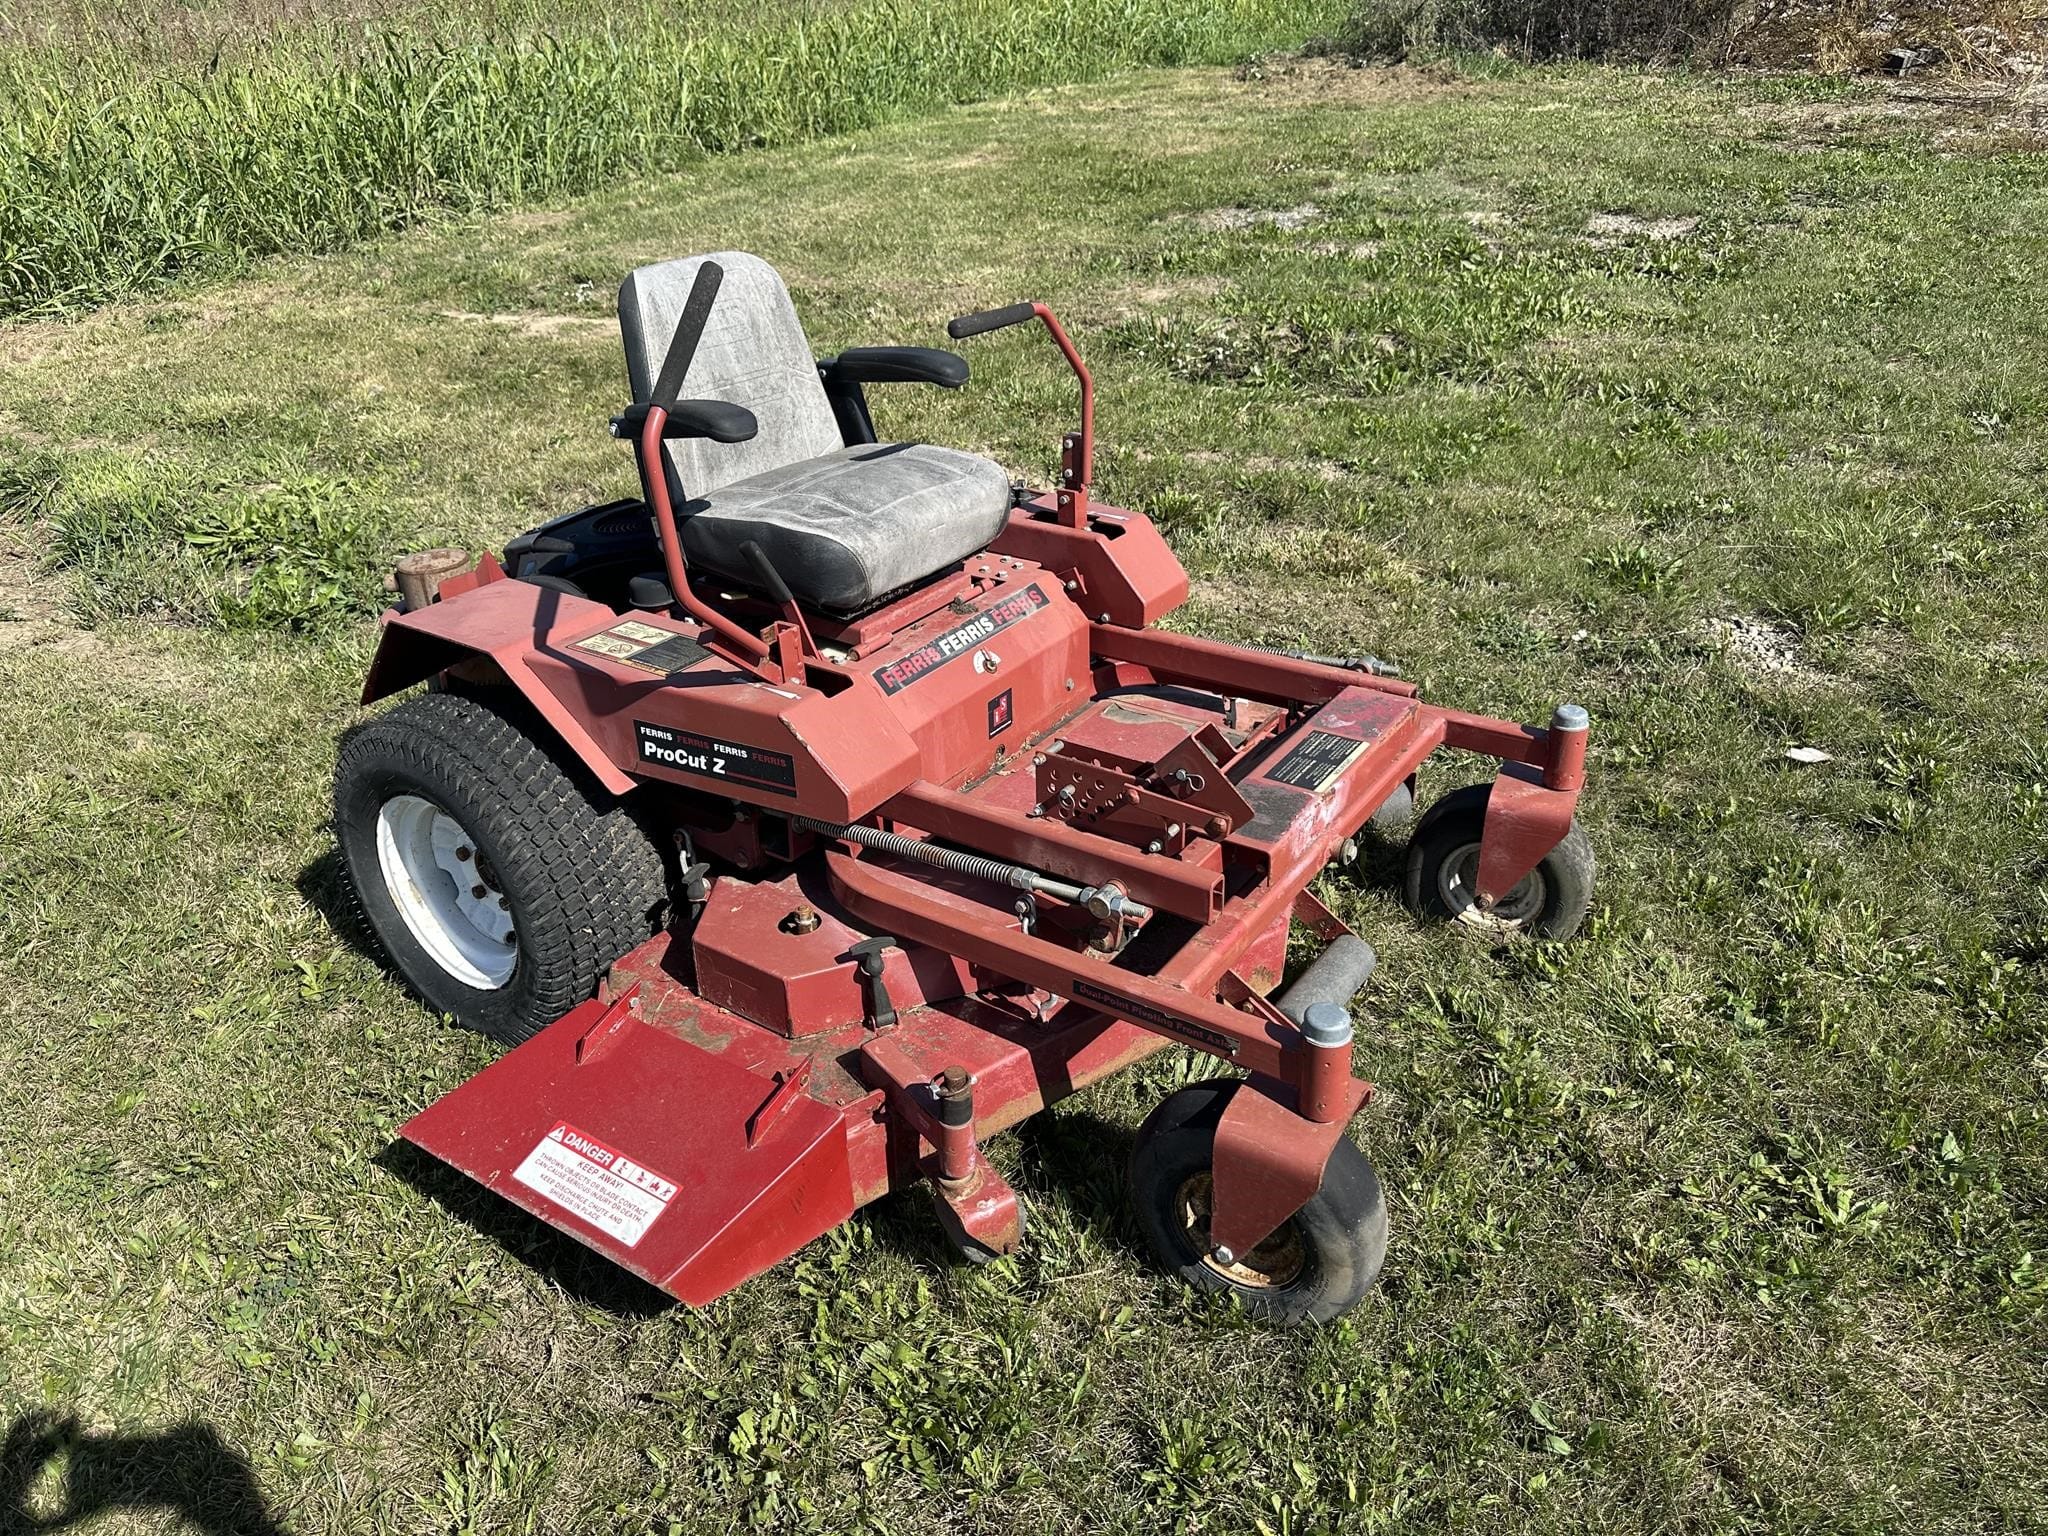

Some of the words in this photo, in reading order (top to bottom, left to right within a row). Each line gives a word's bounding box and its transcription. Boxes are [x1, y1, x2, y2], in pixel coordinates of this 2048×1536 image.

[880, 646, 941, 689] FERRIS
[938, 616, 994, 658] FERRIS
[992, 590, 1043, 626] FERRIS
[640, 726, 673, 741] FERRIS
[676, 735, 710, 749] FERRIS
[713, 743, 748, 759] FERRIS
[752, 752, 787, 767] FERRIS
[644, 741, 708, 770] ProCut
[712, 757, 726, 775] Z
[1131, 1006, 1174, 1029] Pivoting
[1176, 1022, 1204, 1039] Front
[563, 1132, 614, 1166] DANGER
[534, 1158, 548, 1169] CAN
[547, 1166, 567, 1179] CAUSE
[566, 1176, 591, 1194] SERIOUS
[591, 1190, 612, 1205] INJURY
[611, 1202, 622, 1211] OR
[540, 1152, 565, 1170] THROWN
[564, 1166, 591, 1185] OBJECTS
[590, 1181, 601, 1190] OR
[600, 1186, 620, 1201] BLADE
[618, 1197, 648, 1217] CONTACT
[577, 1160, 600, 1175] KEEP
[598, 1172, 624, 1189] AWAY!
[540, 1173, 555, 1185] KEEP
[554, 1182, 589, 1204] DISCHARGE
[588, 1201, 609, 1217] CHUTE
[608, 1213, 623, 1225] AND
